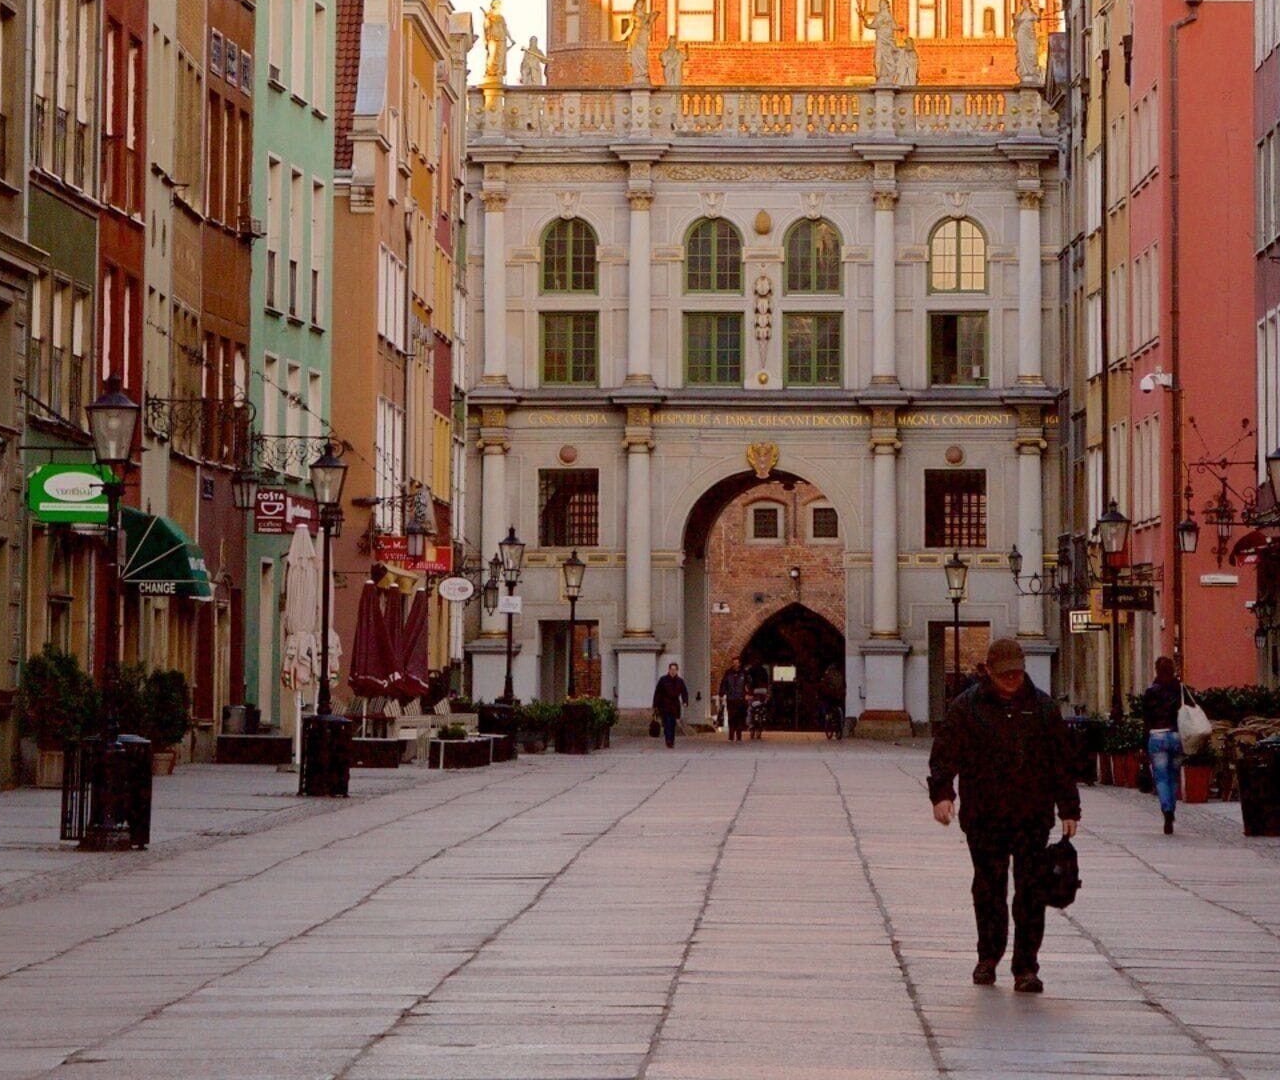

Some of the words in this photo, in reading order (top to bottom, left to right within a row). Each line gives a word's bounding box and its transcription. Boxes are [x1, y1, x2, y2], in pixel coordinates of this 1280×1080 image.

[528, 413, 608, 425] CONCORDIA
[257, 491, 285, 502] COSTA
[139, 582, 176, 594] CHANGE
